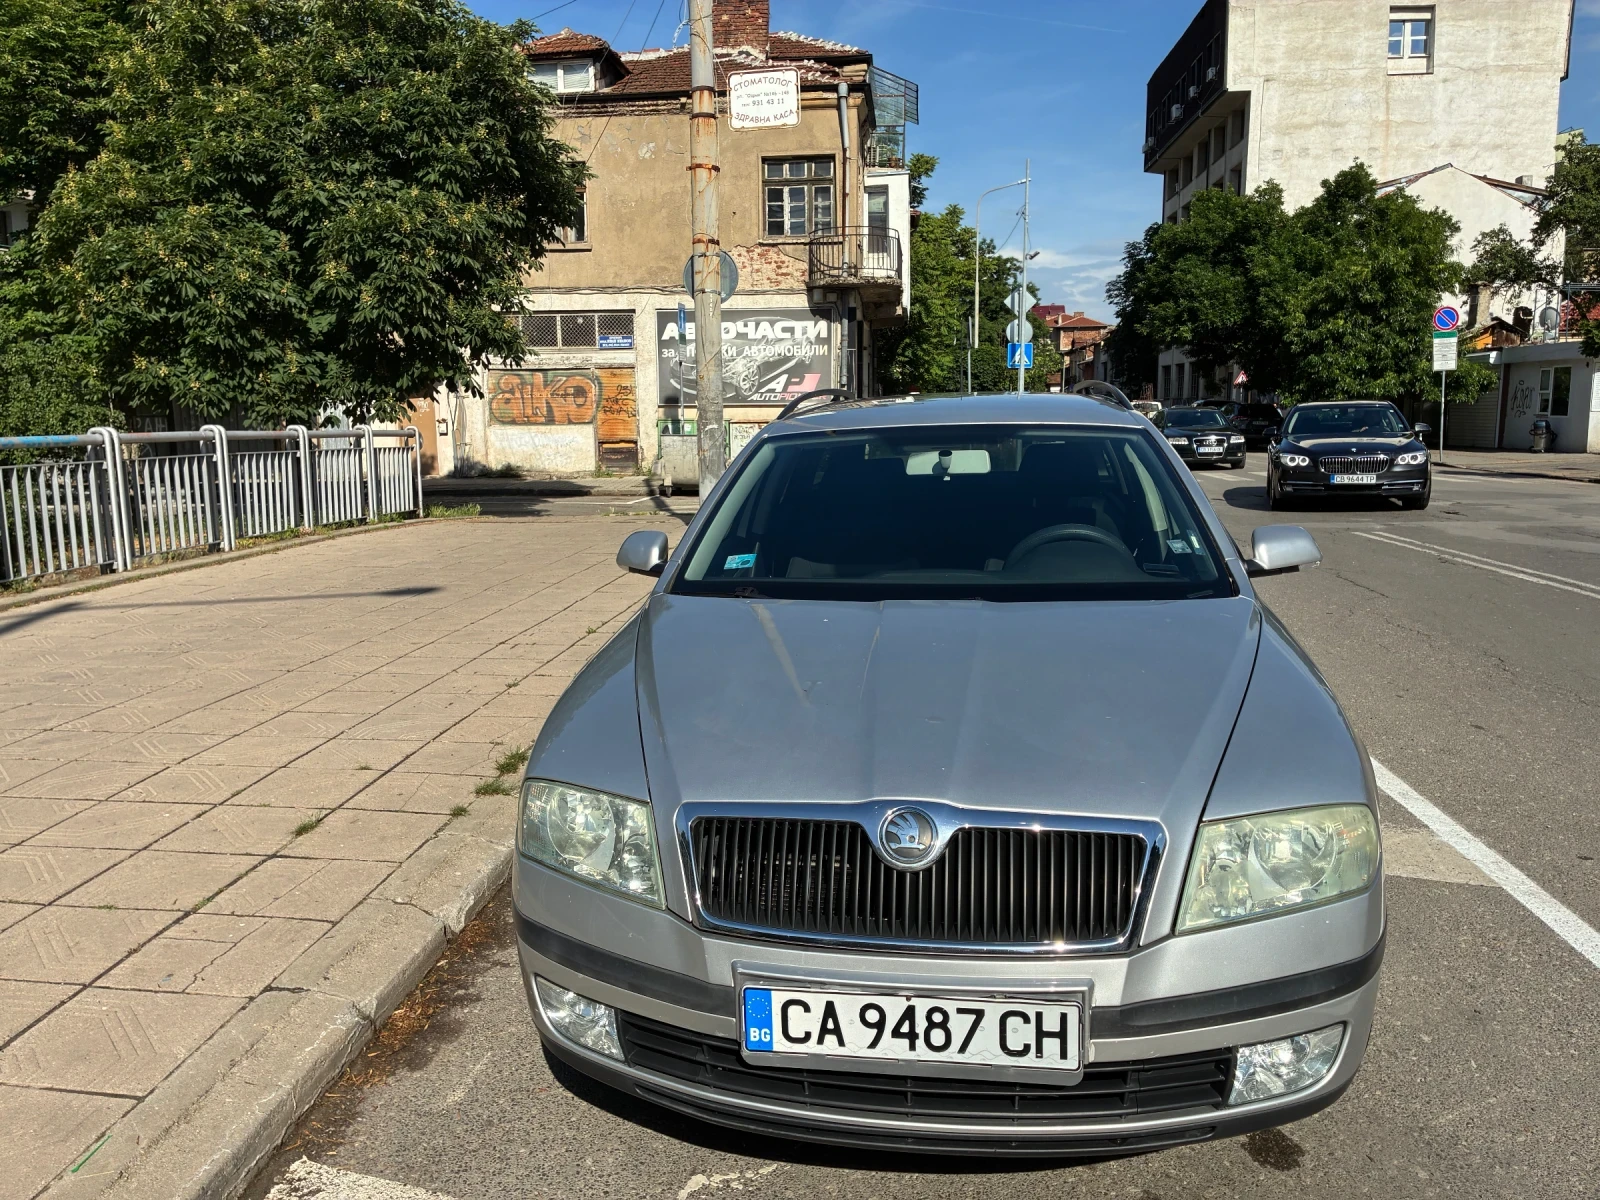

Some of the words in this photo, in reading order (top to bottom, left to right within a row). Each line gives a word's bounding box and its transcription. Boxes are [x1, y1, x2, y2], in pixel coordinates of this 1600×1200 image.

[733, 76, 793, 91] СТОМАТОЛОГ
[734, 112, 771, 124] ЗДРАВНА
[773, 109, 795, 121] КАСА
[661, 320, 828, 340] АВОЧАСТИ
[661, 348, 675, 357] за
[743, 344, 828, 357] АВТОМОБИЛИ
[1346, 475, 1364, 483] 9644
[1365, 475, 1375, 483] TP
[750, 1027, 771, 1043] BG
[780, 998, 846, 1048] CA
[859, 1002, 985, 1055] 9487
[999, 1009, 1068, 1060] CH
